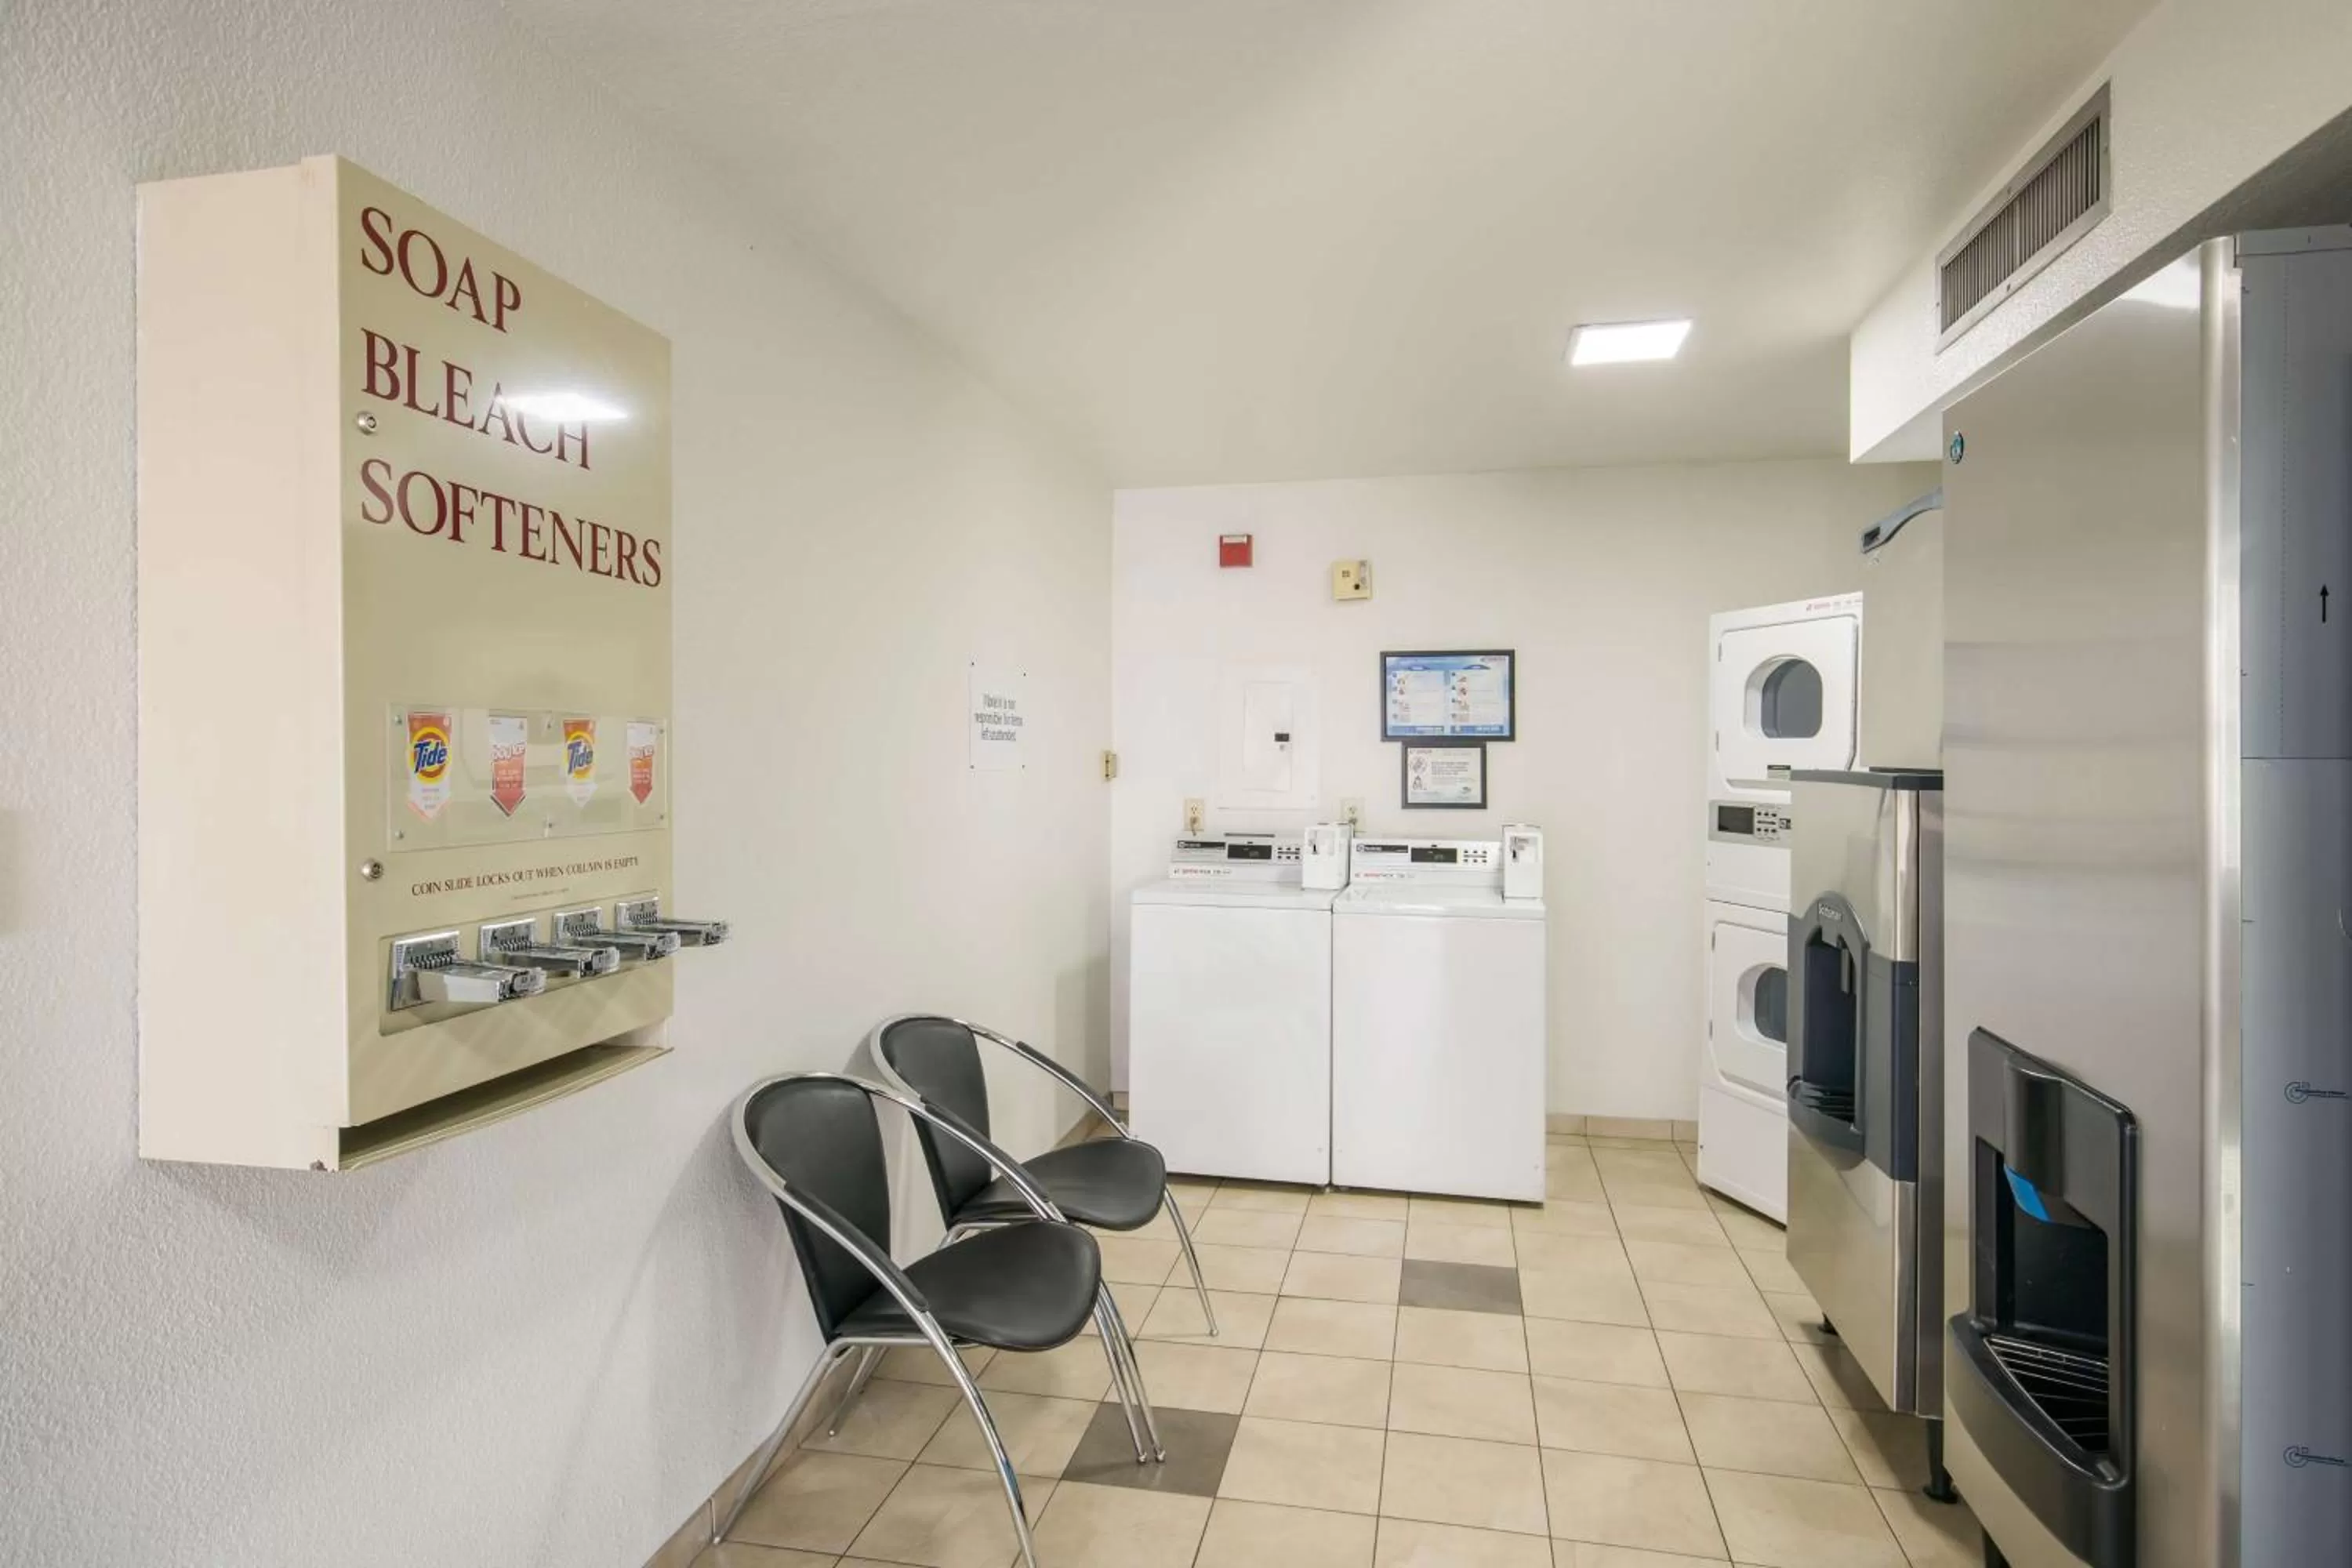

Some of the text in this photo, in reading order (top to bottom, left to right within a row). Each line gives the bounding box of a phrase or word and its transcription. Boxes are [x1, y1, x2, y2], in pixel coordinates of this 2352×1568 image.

[361, 206, 521, 333] SOAP
[361, 328, 590, 470] BLEACH
[361, 459, 662, 587] SOFTENERS
[413, 740, 448, 774] Tide
[567, 739, 593, 775] Tide
[412, 881, 441, 896] COIN
[445, 877, 474, 892] SLIDE
[477, 872, 510, 887] LOCKS
[512, 869, 534, 883] OUT
[536, 866, 564, 879] WHEN
[604, 859, 612, 870] IS
